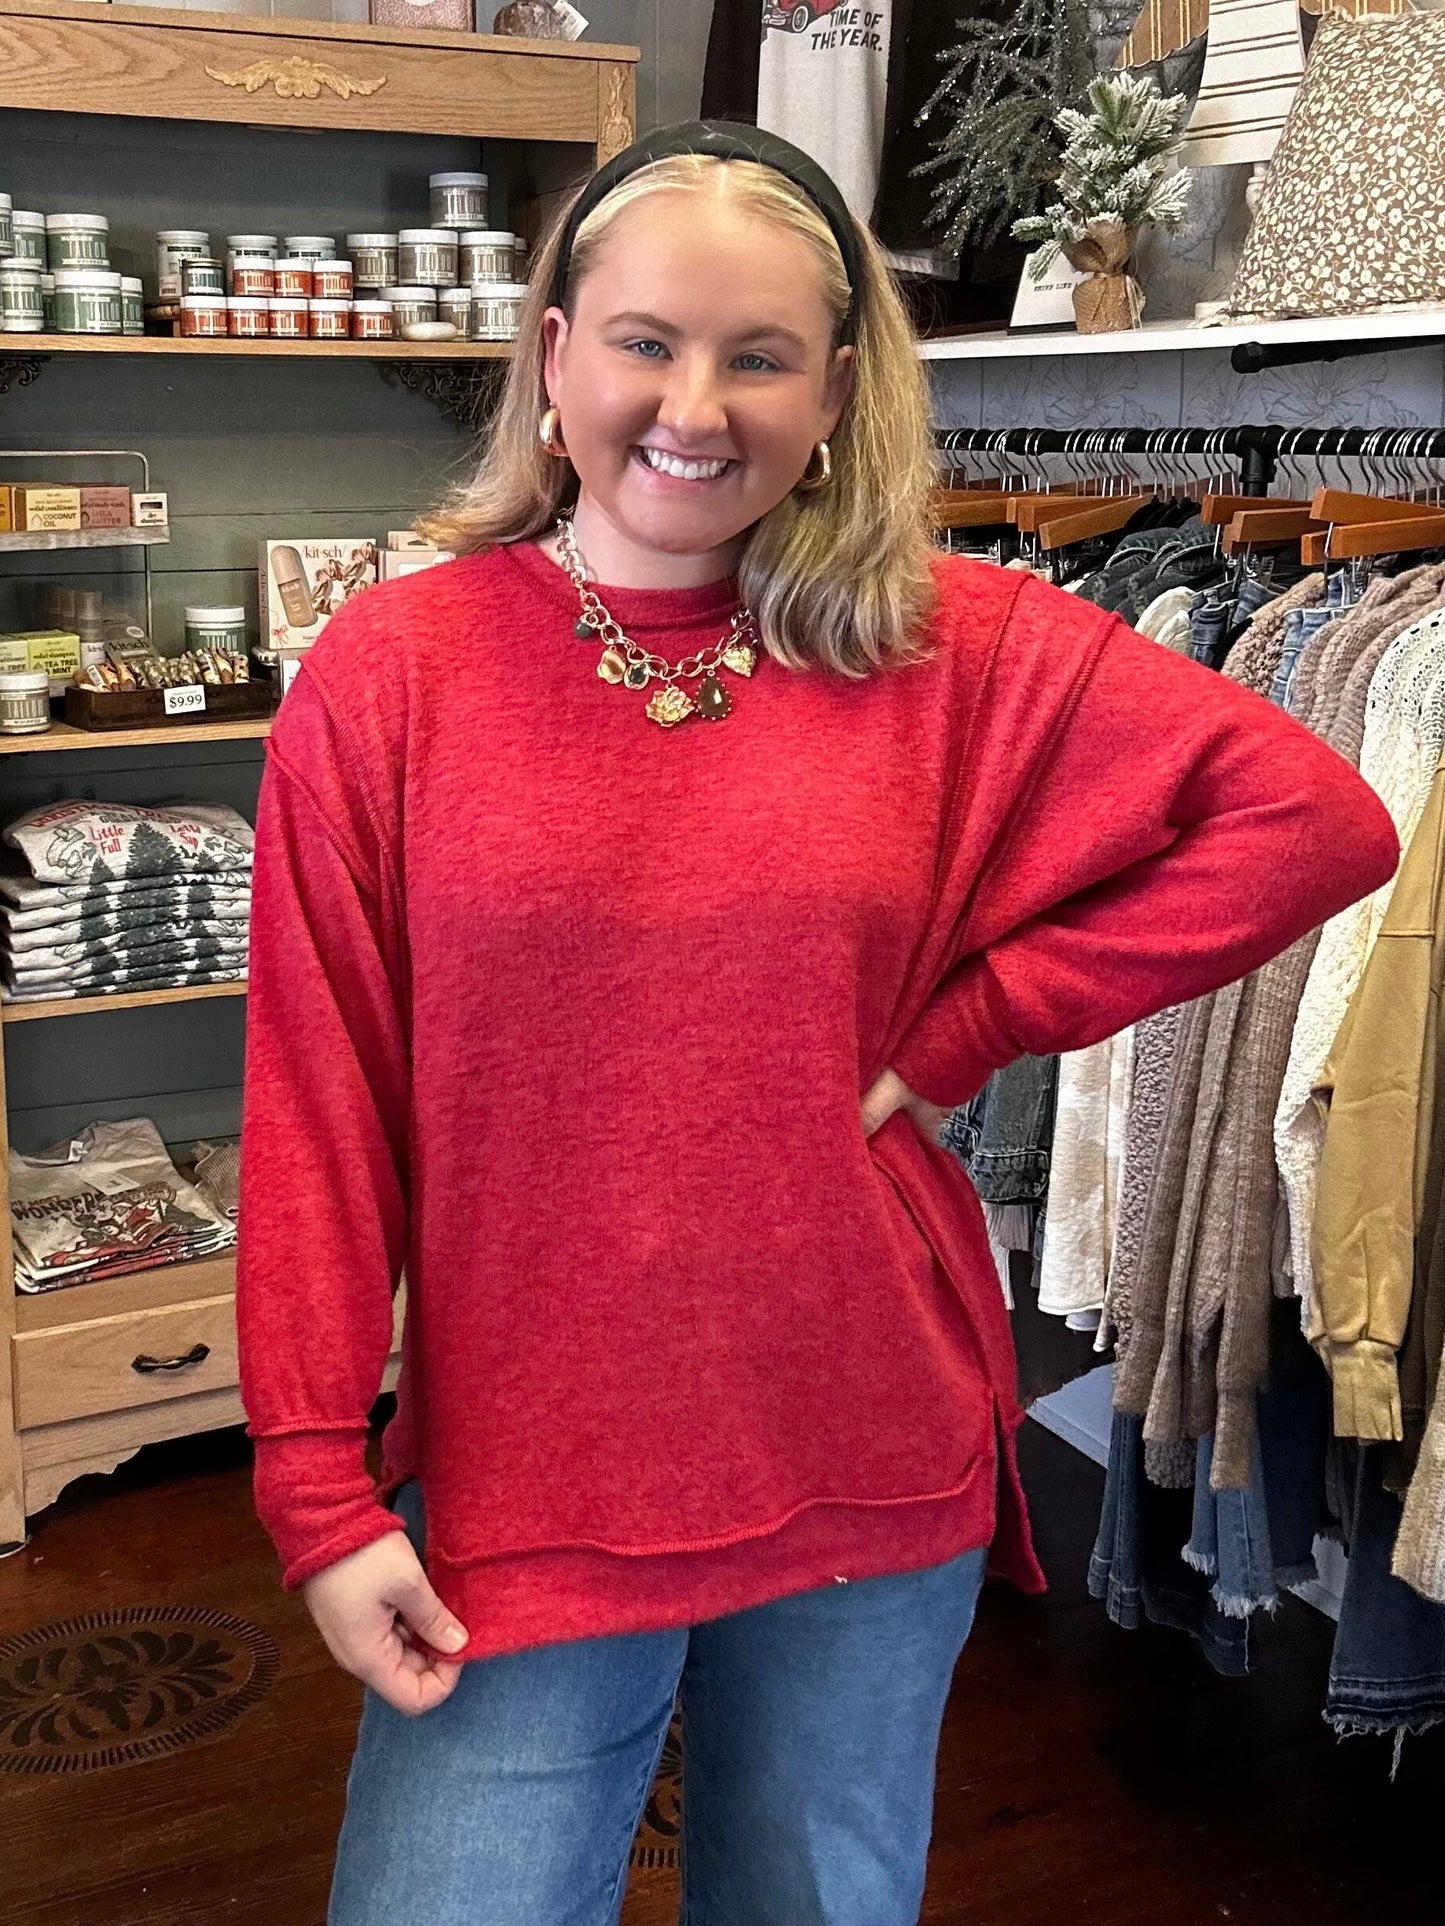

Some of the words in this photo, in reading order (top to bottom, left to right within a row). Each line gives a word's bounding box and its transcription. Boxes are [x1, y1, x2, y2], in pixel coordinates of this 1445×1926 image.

[830, 9, 861, 27] TIME
[864, 12, 883, 29] OF
[811, 31, 836, 50] THE
[840, 29, 883, 51] YEAR.
[43, 512, 76, 520] COCONUT
[169, 693, 202, 708] $9.99
[89, 824, 124, 841] Little
[101, 839, 122, 856] Full
